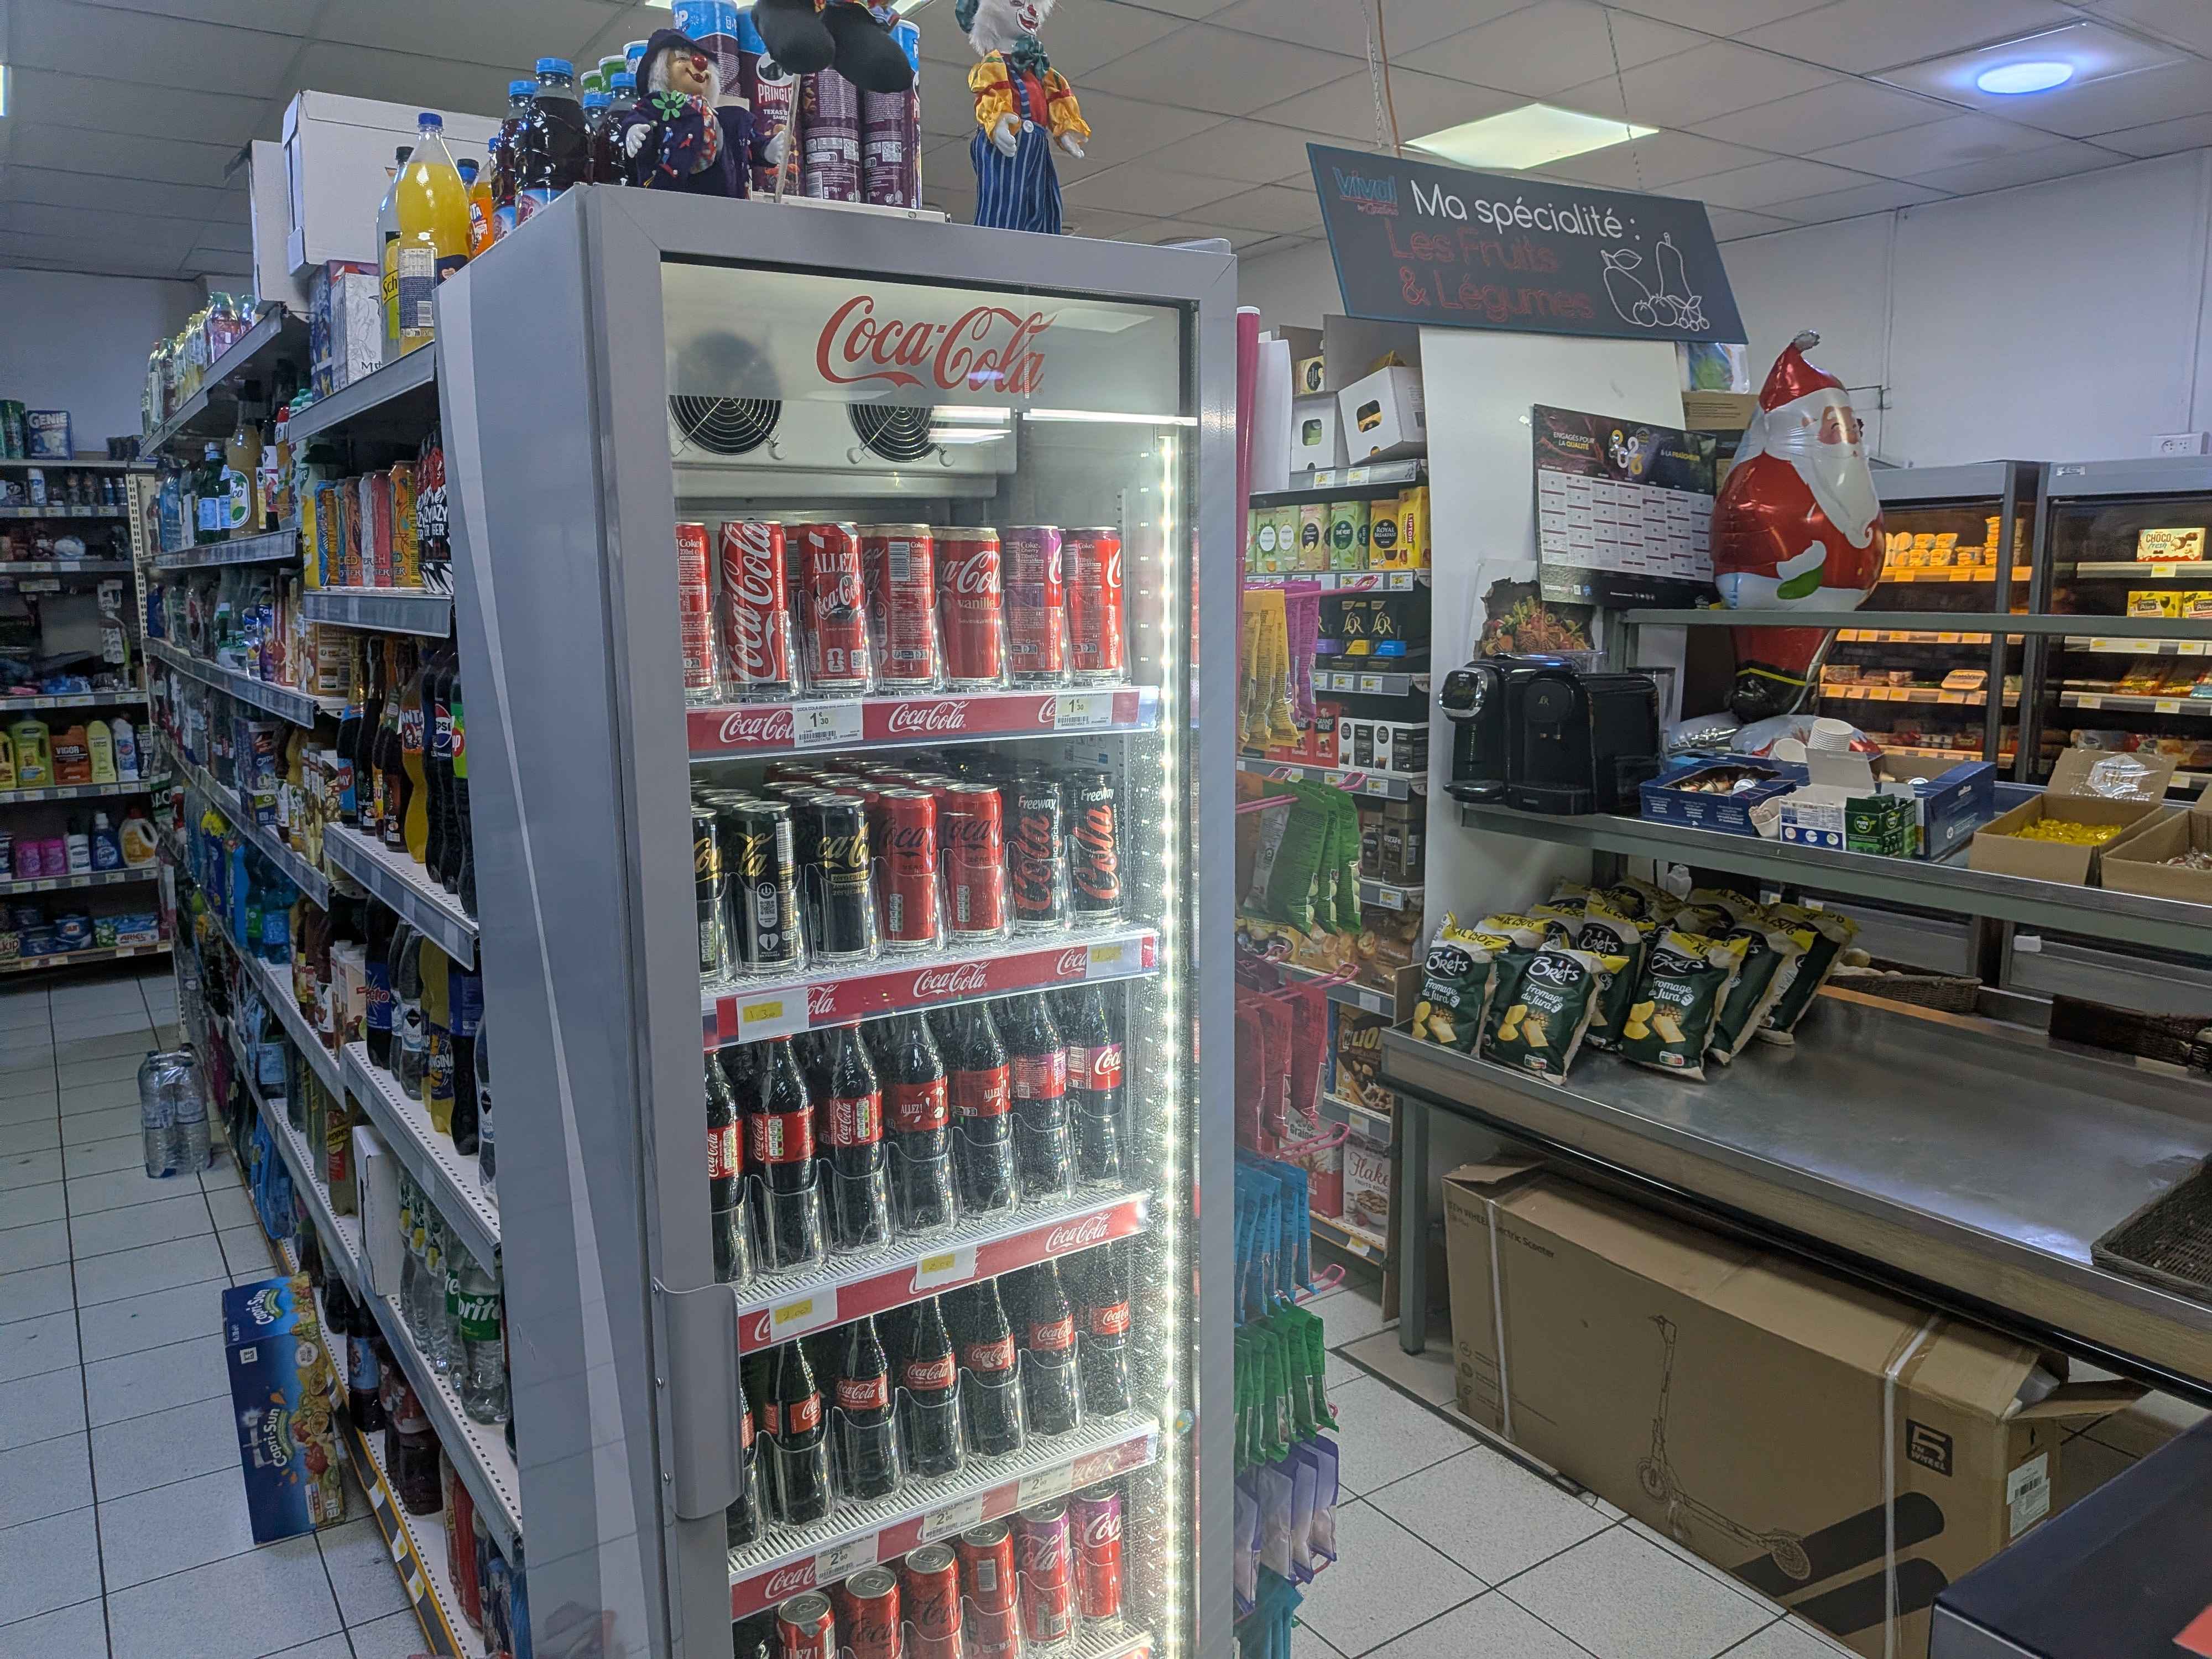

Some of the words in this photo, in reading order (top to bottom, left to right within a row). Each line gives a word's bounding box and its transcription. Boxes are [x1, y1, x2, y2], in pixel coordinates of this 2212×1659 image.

[1410, 180, 1467, 221] Ma
[1478, 195, 1624, 239] spécialité
[1385, 220, 1454, 263] Les
[1458, 227, 1559, 275] Fruits
[1400, 265, 1431, 307] &
[1434, 273, 1596, 322] Légumes
[816, 295, 1057, 395] Coca-Cola
[29, 412, 68, 429] GENIE
[2146, 533, 2172, 543] CHOCO
[812, 553, 855, 573] ALLEZ
[722, 522, 776, 682] Coca-Cola
[888, 701, 970, 733] Coca-Cola
[56, 746, 81, 755] VIGOR
[1018, 795, 1056, 811] Freeway
[1081, 787, 1114, 802] Freeway
[1580, 928, 1619, 952] Brets
[1425, 952, 1469, 976] Brets
[1528, 957, 1580, 985] Brets
[1652, 952, 1705, 973] Brets
[914, 960, 992, 996] Coca-Cola
[1425, 978, 1458, 995] Fromage
[1422, 989, 1430, 997] du
[1430, 990, 1450, 1005] Jura
[1521, 992, 1531, 1001] du
[1531, 995, 1552, 1011] Jura
[1526, 983, 1563, 1004] Fromage
[1045, 1213, 1113, 1253] Coca-Cola
[247, 1289, 275, 1326] Capri-Sun
[264, 1408, 288, 1468] Capri-Sun
